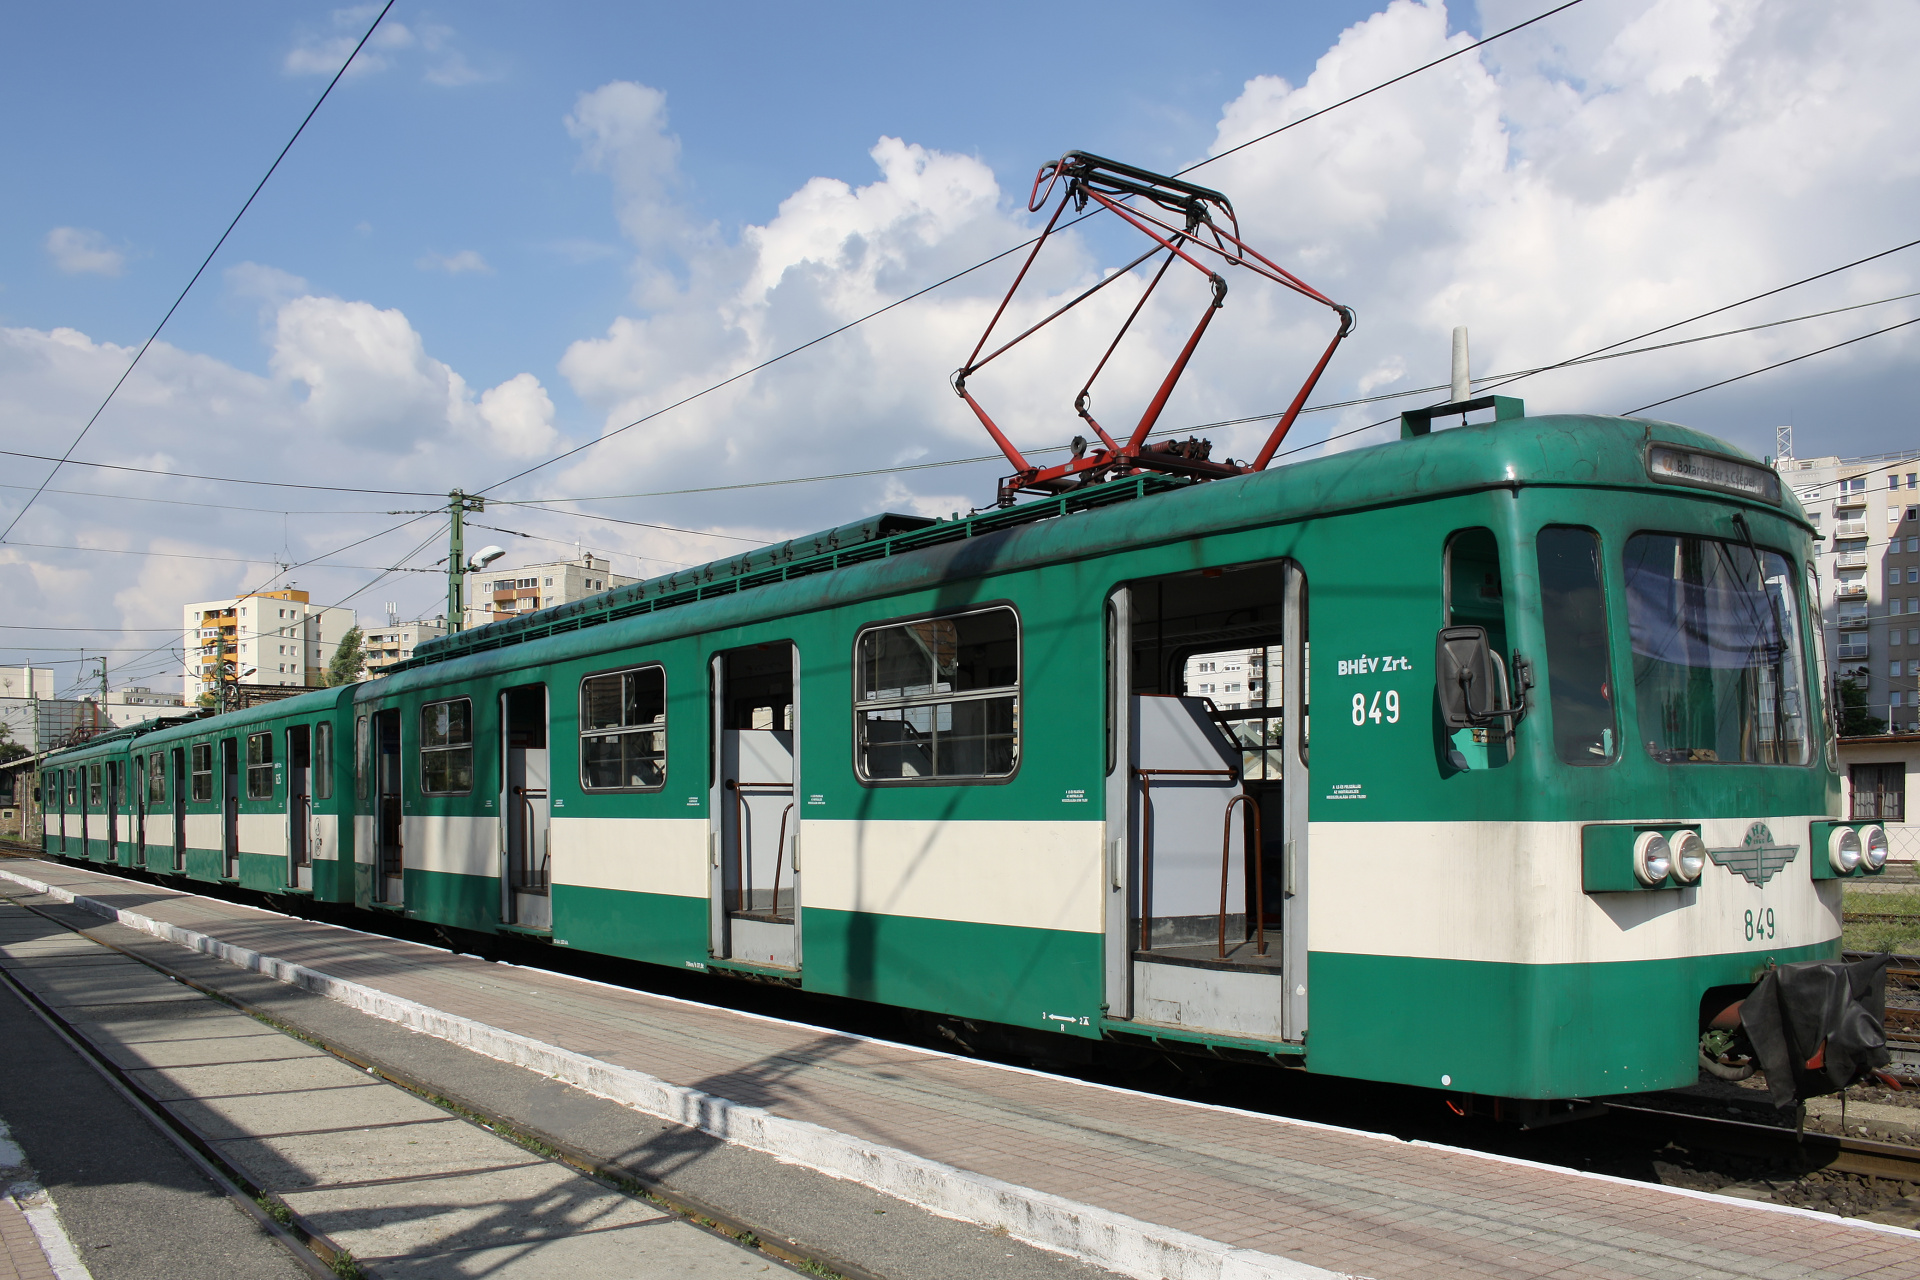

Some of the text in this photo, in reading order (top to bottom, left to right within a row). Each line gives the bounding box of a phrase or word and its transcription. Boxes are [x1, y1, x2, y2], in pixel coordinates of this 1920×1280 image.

[1677, 459, 1710, 479] Boráros
[1711, 466, 1724, 481] tér
[1338, 654, 1412, 675] BHÉV Zrt.
[1352, 690, 1399, 726] 849
[1744, 907, 1775, 941] 849
[1060, 1024, 1065, 1032] R
